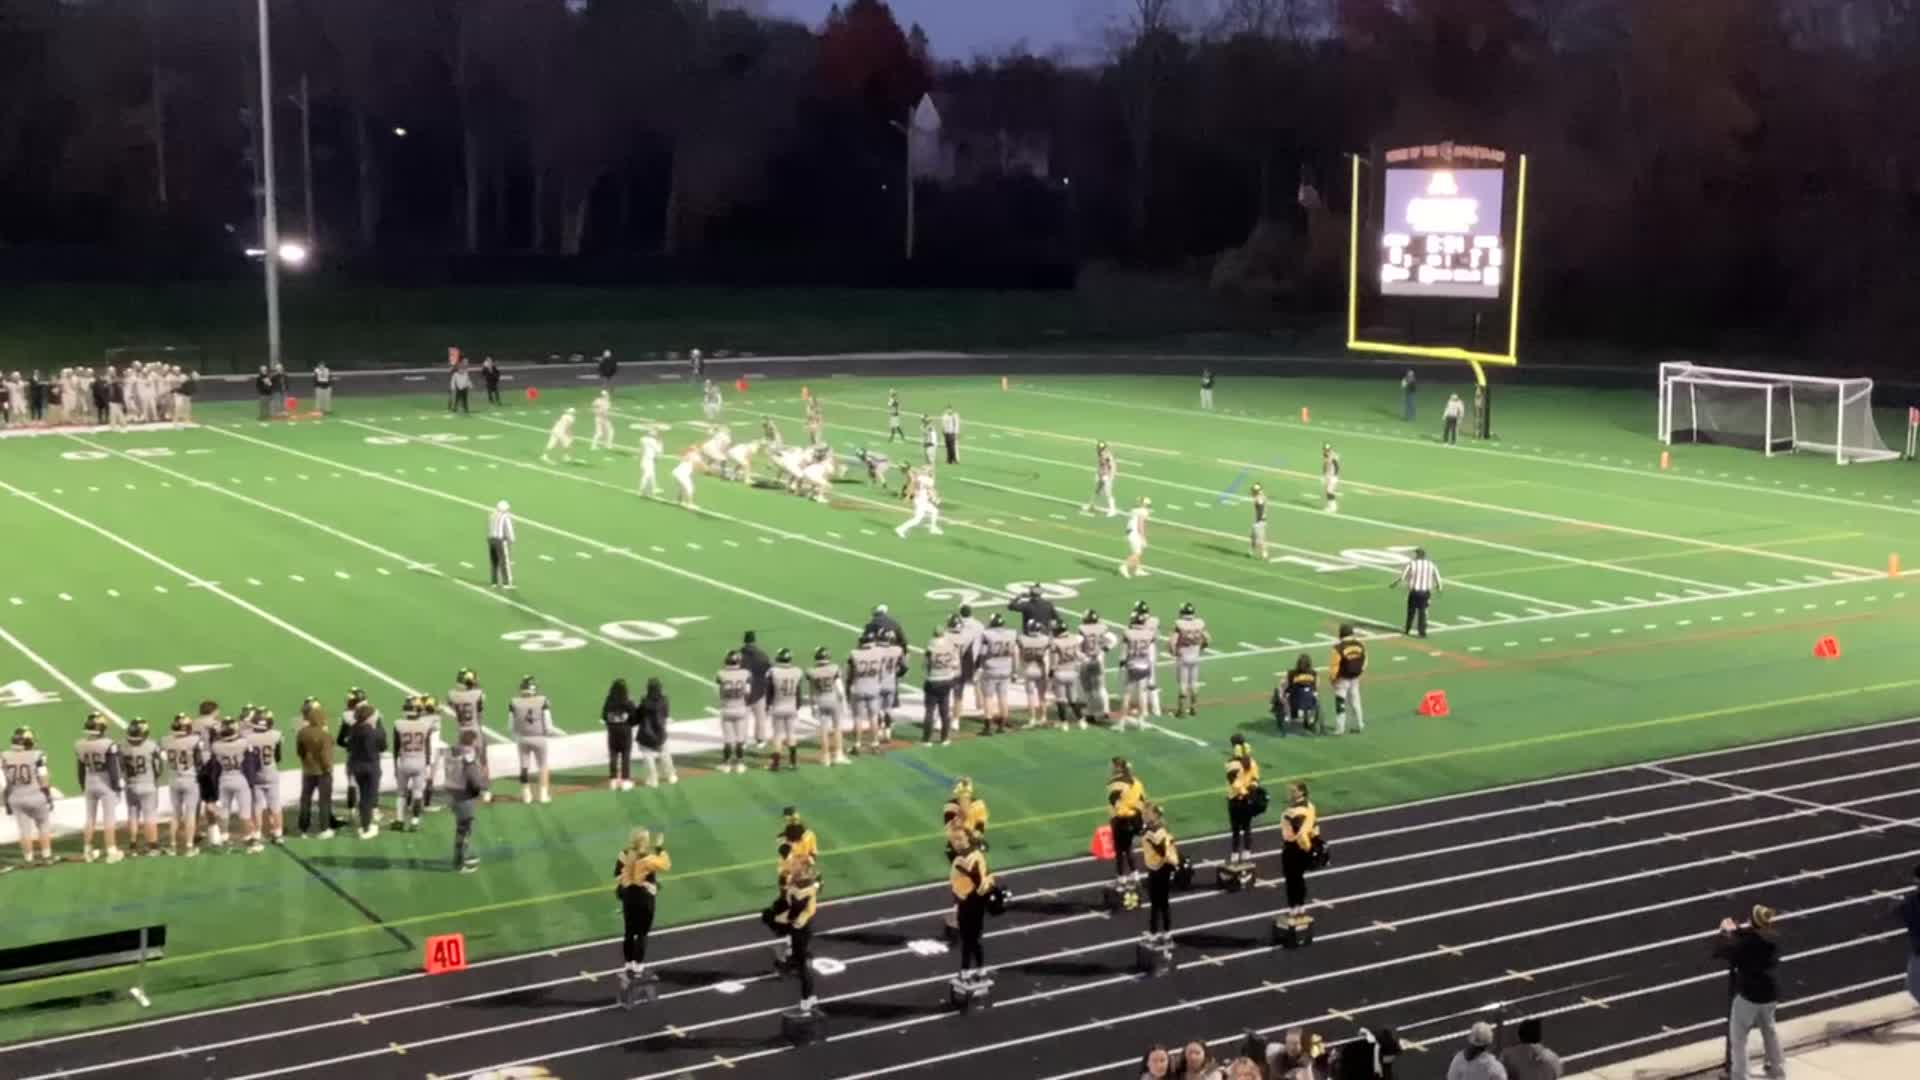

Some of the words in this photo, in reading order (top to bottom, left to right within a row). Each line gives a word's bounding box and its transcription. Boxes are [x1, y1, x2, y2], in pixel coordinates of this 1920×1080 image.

[500, 619, 680, 652] 30
[0, 668, 177, 707] 40
[433, 939, 461, 968] 40
